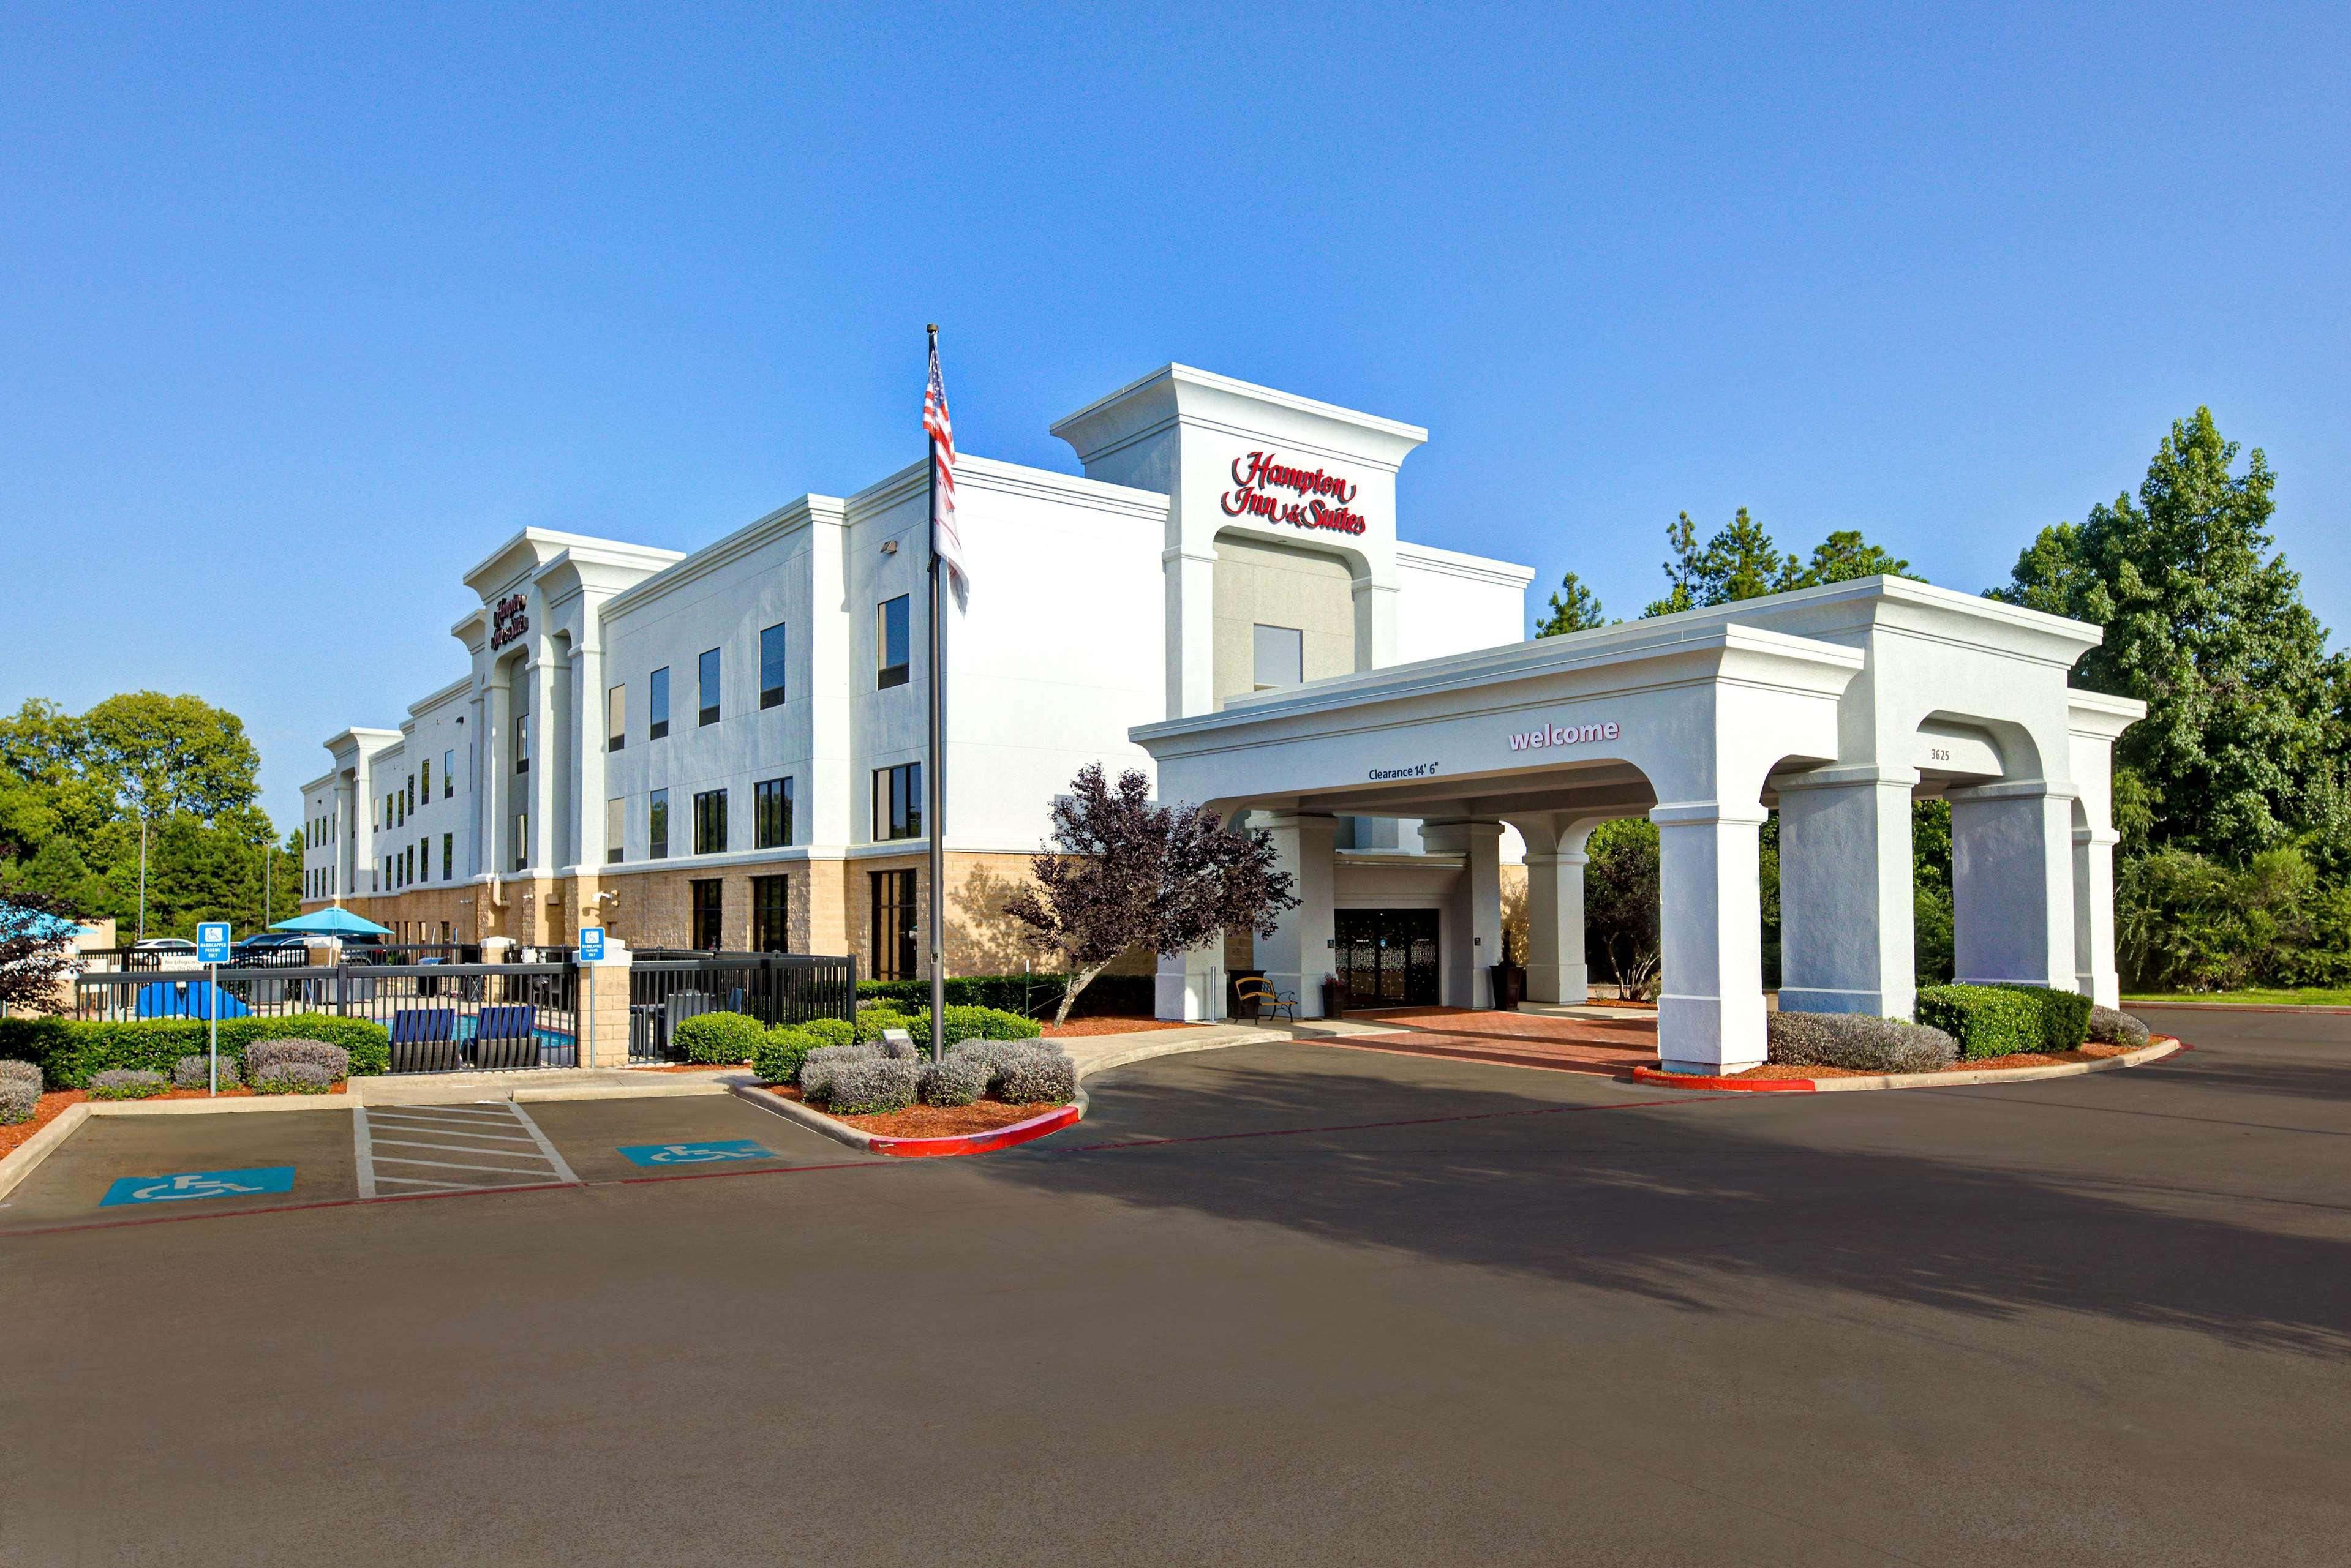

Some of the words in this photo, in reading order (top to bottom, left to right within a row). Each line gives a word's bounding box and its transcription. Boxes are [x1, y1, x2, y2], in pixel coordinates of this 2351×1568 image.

[1232, 452, 1356, 503] Hampton
[1221, 487, 1288, 524] Inn
[1285, 504, 1303, 528] &
[1300, 499, 1366, 536] Suites
[1508, 722, 1620, 751] welcome
[1932, 749, 1949, 760] 3625
[1369, 768, 1413, 779] Clearance
[1415, 763, 1426, 776] 14'
[1429, 762, 1439, 774] 6"
